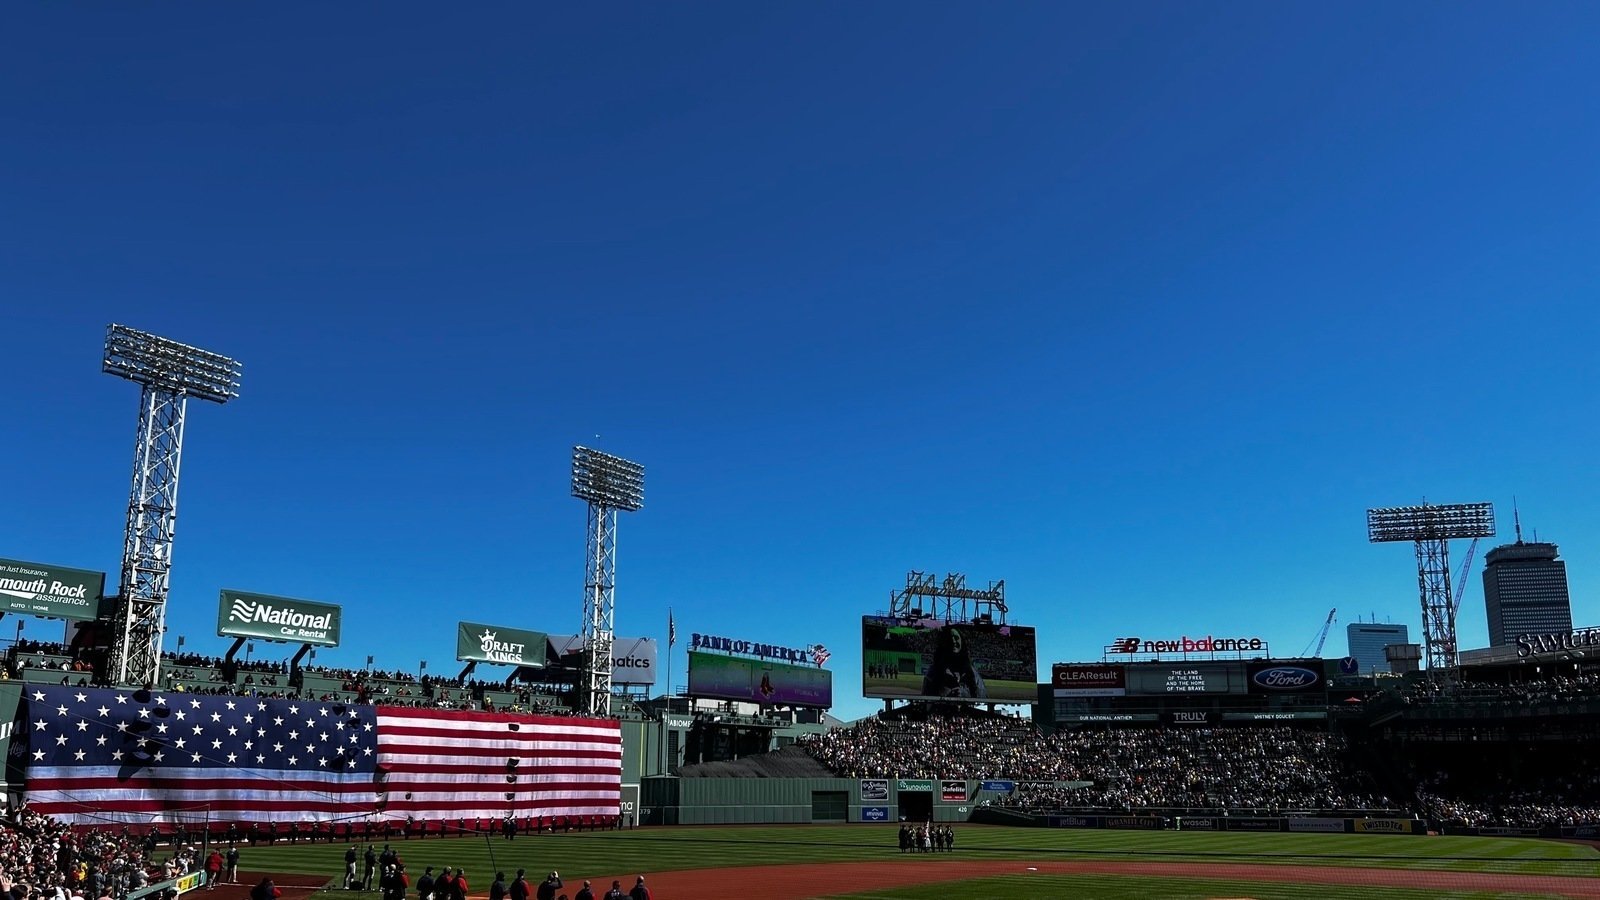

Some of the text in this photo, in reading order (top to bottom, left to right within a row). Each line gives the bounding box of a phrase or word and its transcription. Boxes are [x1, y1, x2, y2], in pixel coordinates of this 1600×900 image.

[7, 565, 18, 573] Just
[49, 580, 87, 598] Rock
[280, 626, 326, 638] Car Rental
[480, 640, 524, 654] DRAFT
[692, 632, 808, 663] BANK OF AMERICA
[1144, 640, 1180, 652] new
[1182, 635, 1262, 652] balance
[486, 650, 522, 662] KINGS
[1060, 671, 1118, 680] CLEAResult
[1266, 670, 1304, 684] Ford
[1173, 712, 1206, 720] TRULY
[1182, 818, 1212, 826] wasabi
[1362, 820, 1390, 830] TWISTED
